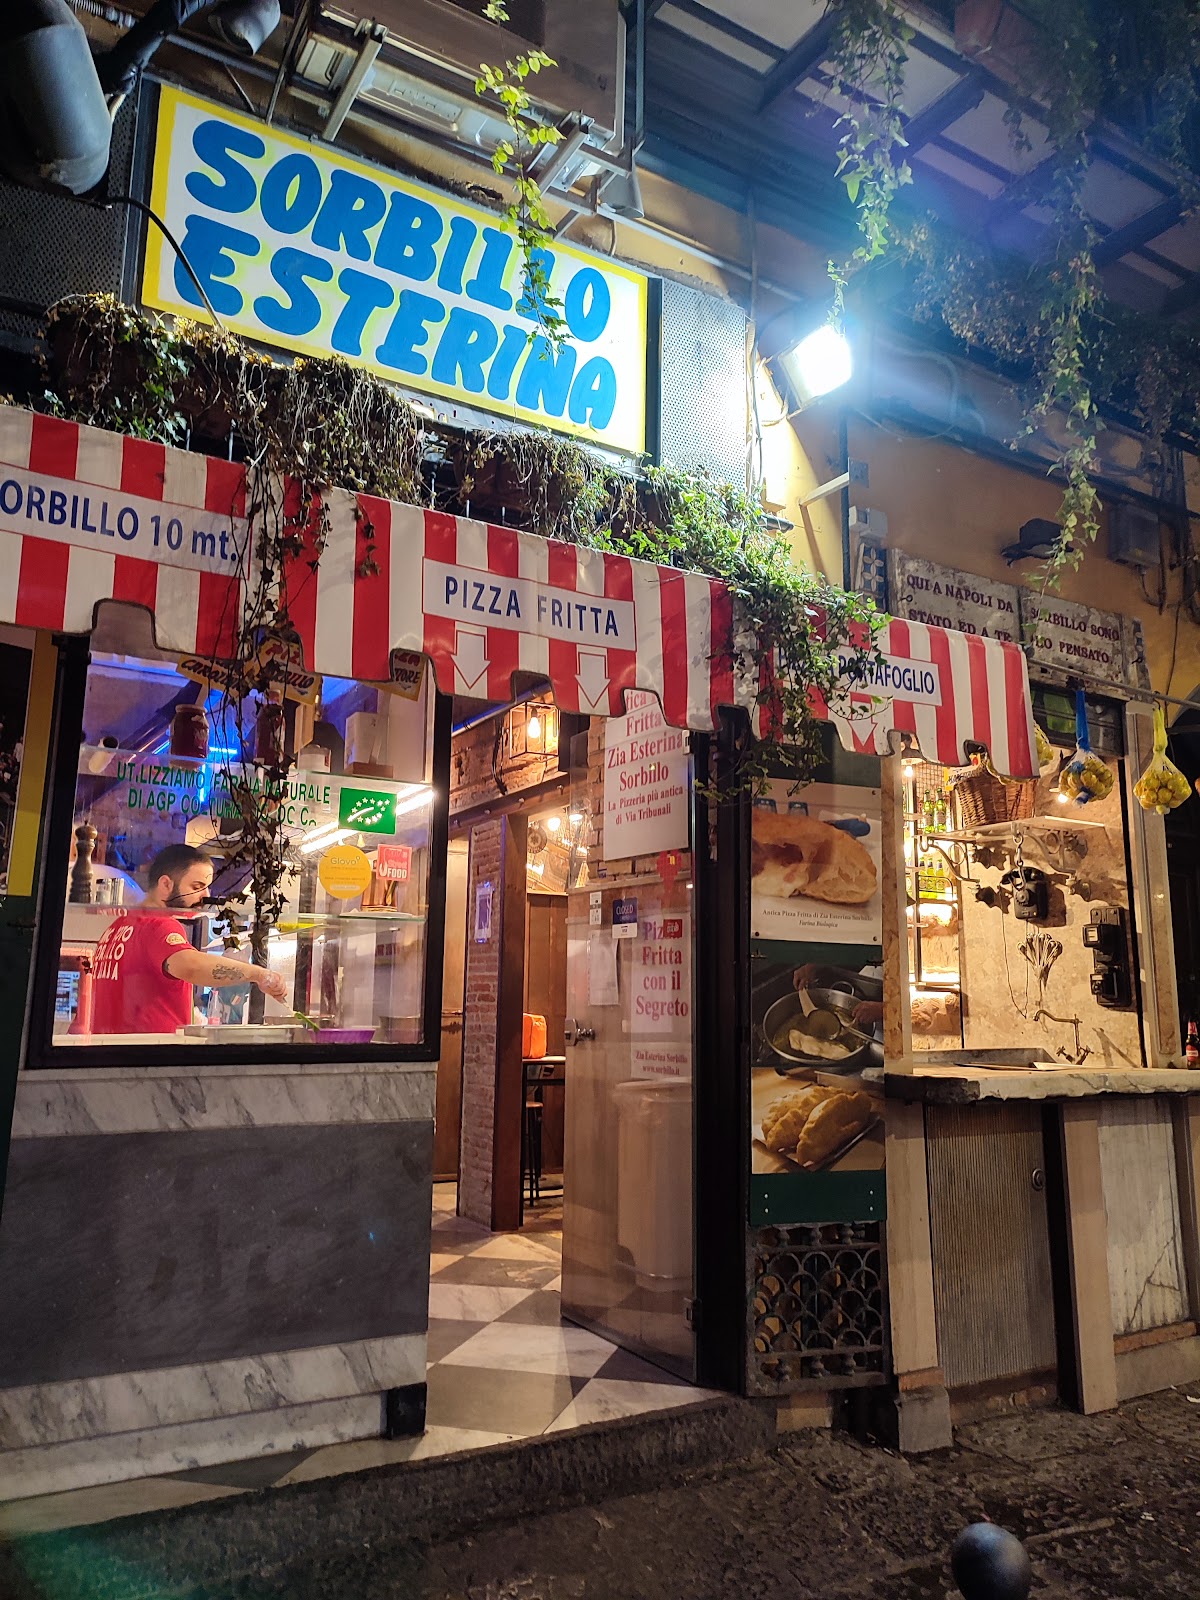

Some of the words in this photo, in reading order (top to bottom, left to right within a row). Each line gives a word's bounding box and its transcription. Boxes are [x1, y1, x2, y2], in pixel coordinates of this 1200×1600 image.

[184, 119, 611, 343] SORBILLO
[174, 214, 617, 430] ESTERINA
[151, 515, 183, 551] 10
[191, 530, 237, 562] mt.
[445, 575, 521, 619] PIZZA
[537, 594, 619, 637] FRITTA
[907, 574, 930, 591] QUI
[933, 581, 942, 595] A
[945, 584, 993, 608] NAPOLI
[997, 598, 1014, 614] DA
[1090, 624, 1119, 641] SONO
[909, 608, 952, 629] STATO
[958, 620, 976, 635] ED
[981, 626, 989, 637] A
[626, 711, 662, 737] Fritta
[607, 746, 626, 769] Zia
[630, 730, 683, 763] Esterina
[117, 761, 206, 790] UTLIZZIAMO
[619, 761, 669, 792] Sorbillo
[128, 788, 142, 808] DI
[608, 801, 616, 812] La
[619, 792, 646, 809] Pizzeria
[647, 788, 659, 805] più
[660, 784, 684, 799] antica
[615, 814, 622, 825] di
[626, 810, 636, 823] Via
[638, 804, 671, 821] Tribunali
[330, 856, 358, 865] Glovo
[388, 868, 408, 879] FOOD
[616, 904, 634, 916] CLOSED
[642, 946, 683, 966] Fritta
[643, 974, 667, 991] con
[671, 970, 681, 991] il
[636, 995, 689, 1021] Segreto
